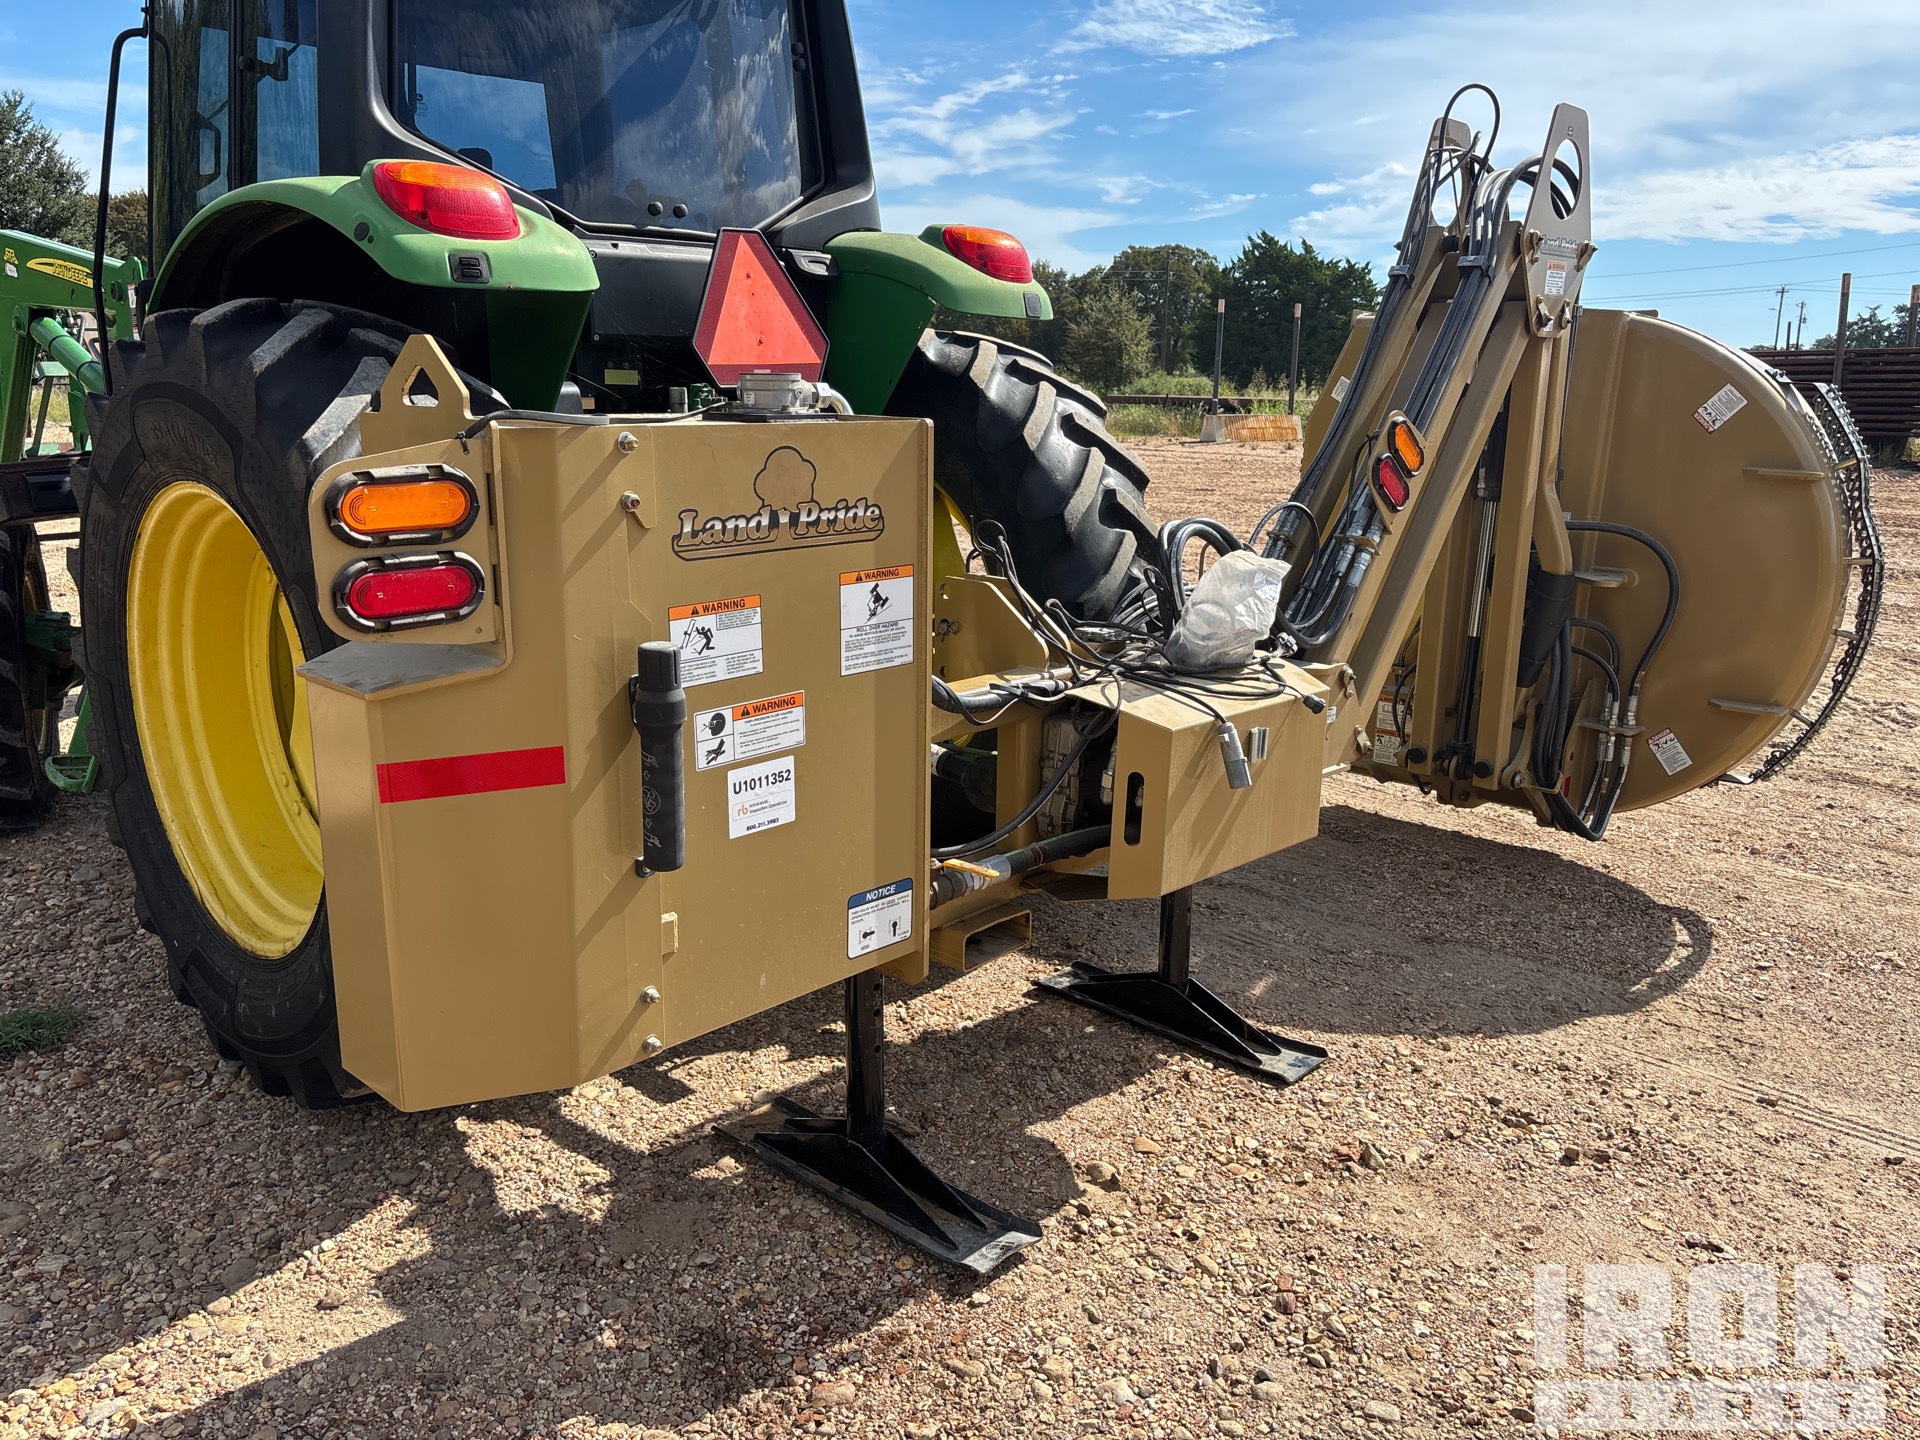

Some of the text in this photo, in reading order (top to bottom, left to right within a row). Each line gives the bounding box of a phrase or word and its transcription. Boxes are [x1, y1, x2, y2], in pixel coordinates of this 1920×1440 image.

[52, 260, 88, 285] JOHN DEERE
[676, 496, 881, 548] Land Pride
[864, 568, 900, 580] WARNING
[702, 598, 746, 614] WARNING
[752, 696, 796, 714] WARNING
[733, 769, 791, 794] U1011352
[738, 804, 748, 816] rb
[866, 884, 896, 902] NOTICE
